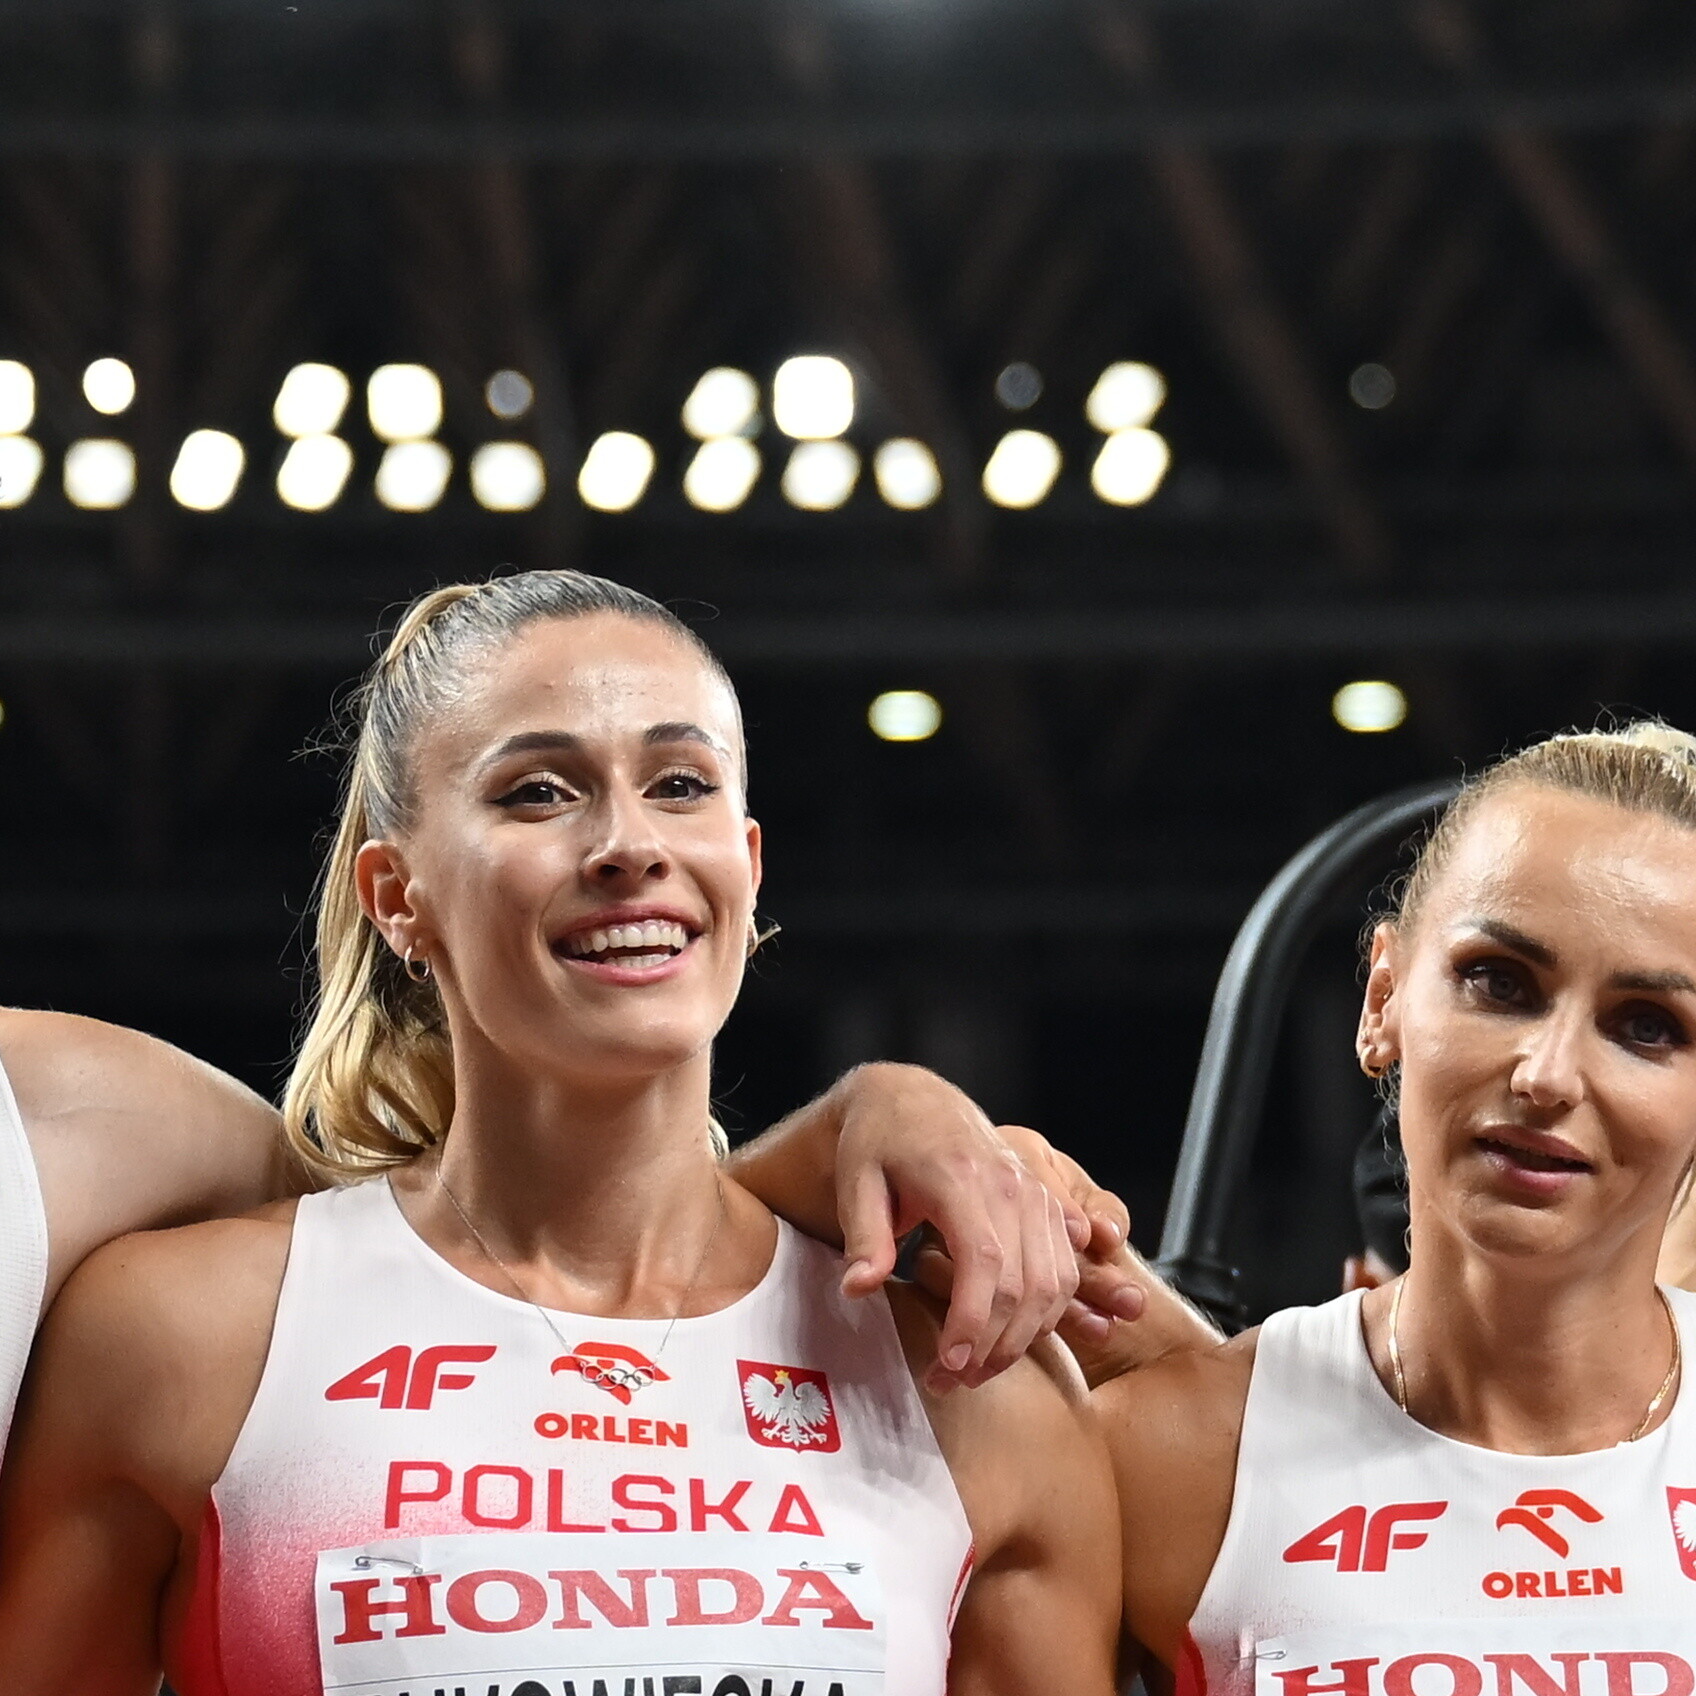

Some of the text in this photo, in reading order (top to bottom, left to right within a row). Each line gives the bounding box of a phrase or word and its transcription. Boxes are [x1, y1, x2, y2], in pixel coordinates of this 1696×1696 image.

[325, 1345, 497, 1410] 4F
[534, 1413, 688, 1448] ORLEN
[384, 1461, 824, 1537] POLSKA
[1282, 1501, 1448, 1572] 4F
[330, 1569, 874, 1645] HONDA
[1481, 1567, 1623, 1599] ORLEN
